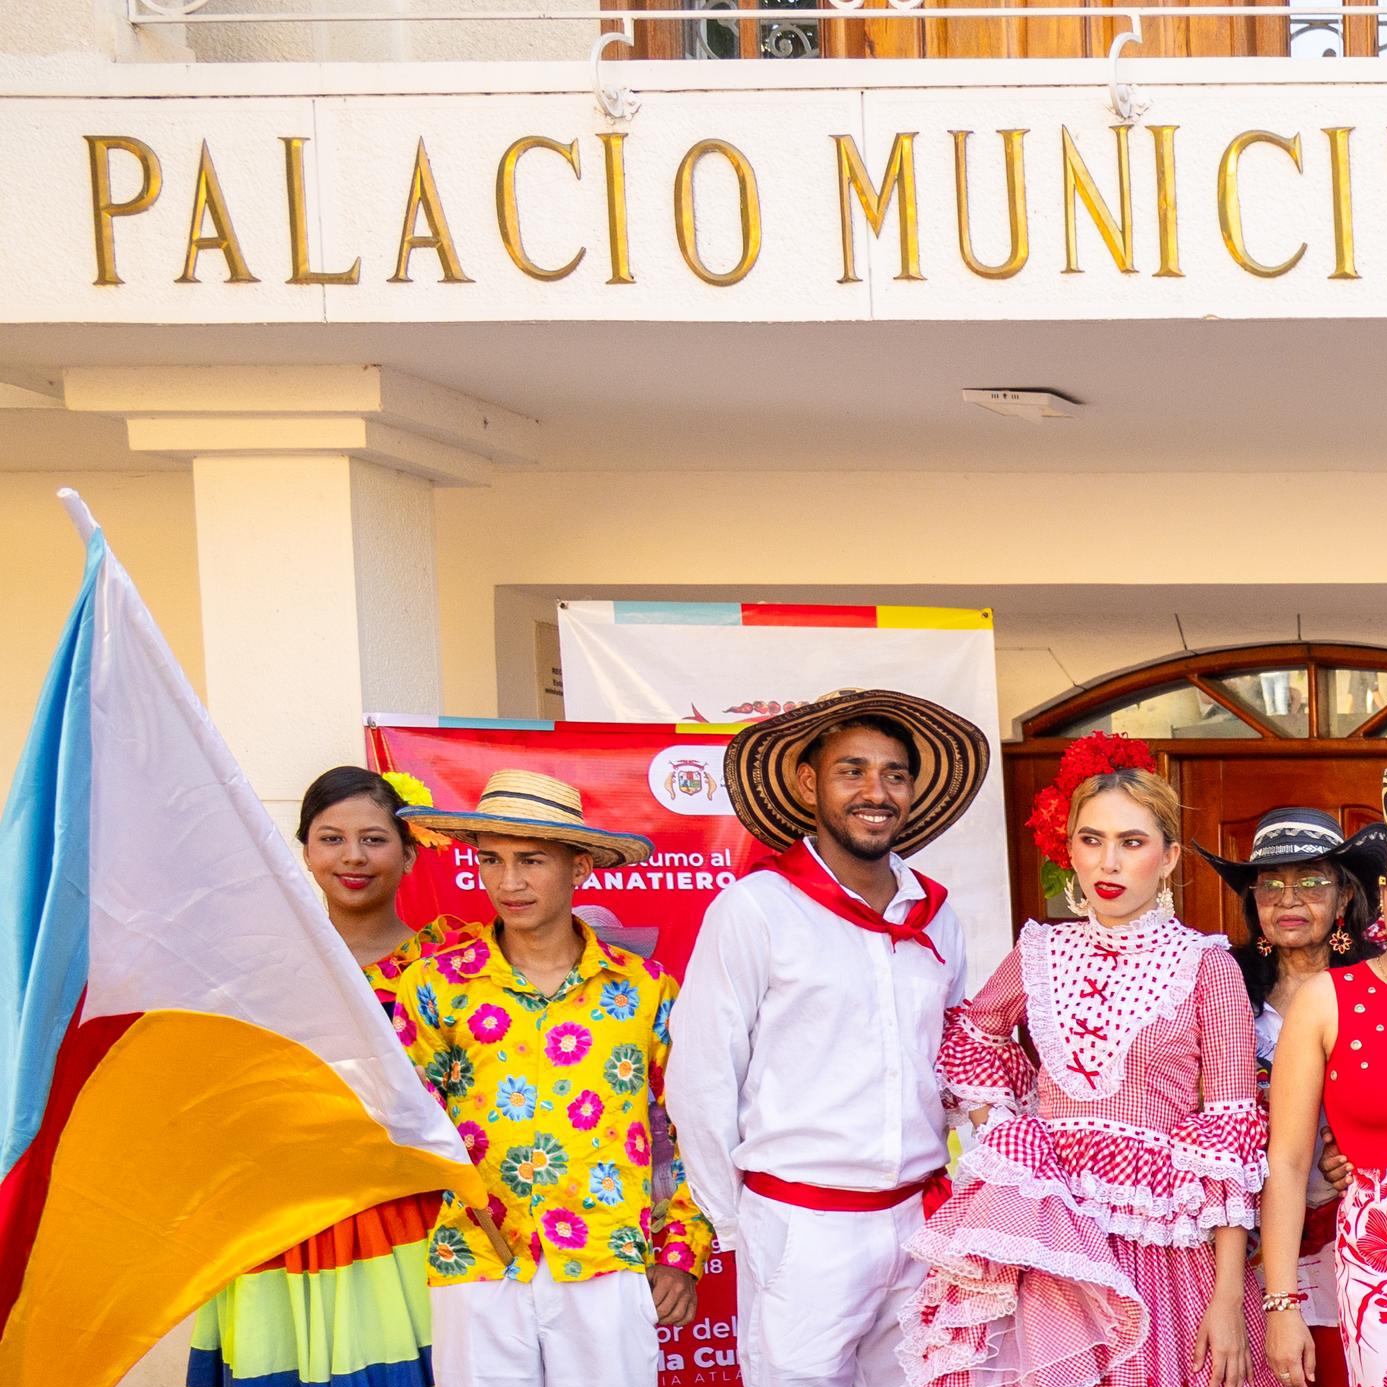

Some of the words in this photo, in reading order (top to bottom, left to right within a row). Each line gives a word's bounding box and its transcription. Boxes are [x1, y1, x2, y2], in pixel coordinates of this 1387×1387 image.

[82, 131, 763, 287] PALACIO
[627, 851, 705, 867] umo
[711, 847, 732, 867] al
[575, 871, 737, 890] ANATIERO
[692, 1315, 738, 1340] del
[693, 1346, 740, 1368] Cu
